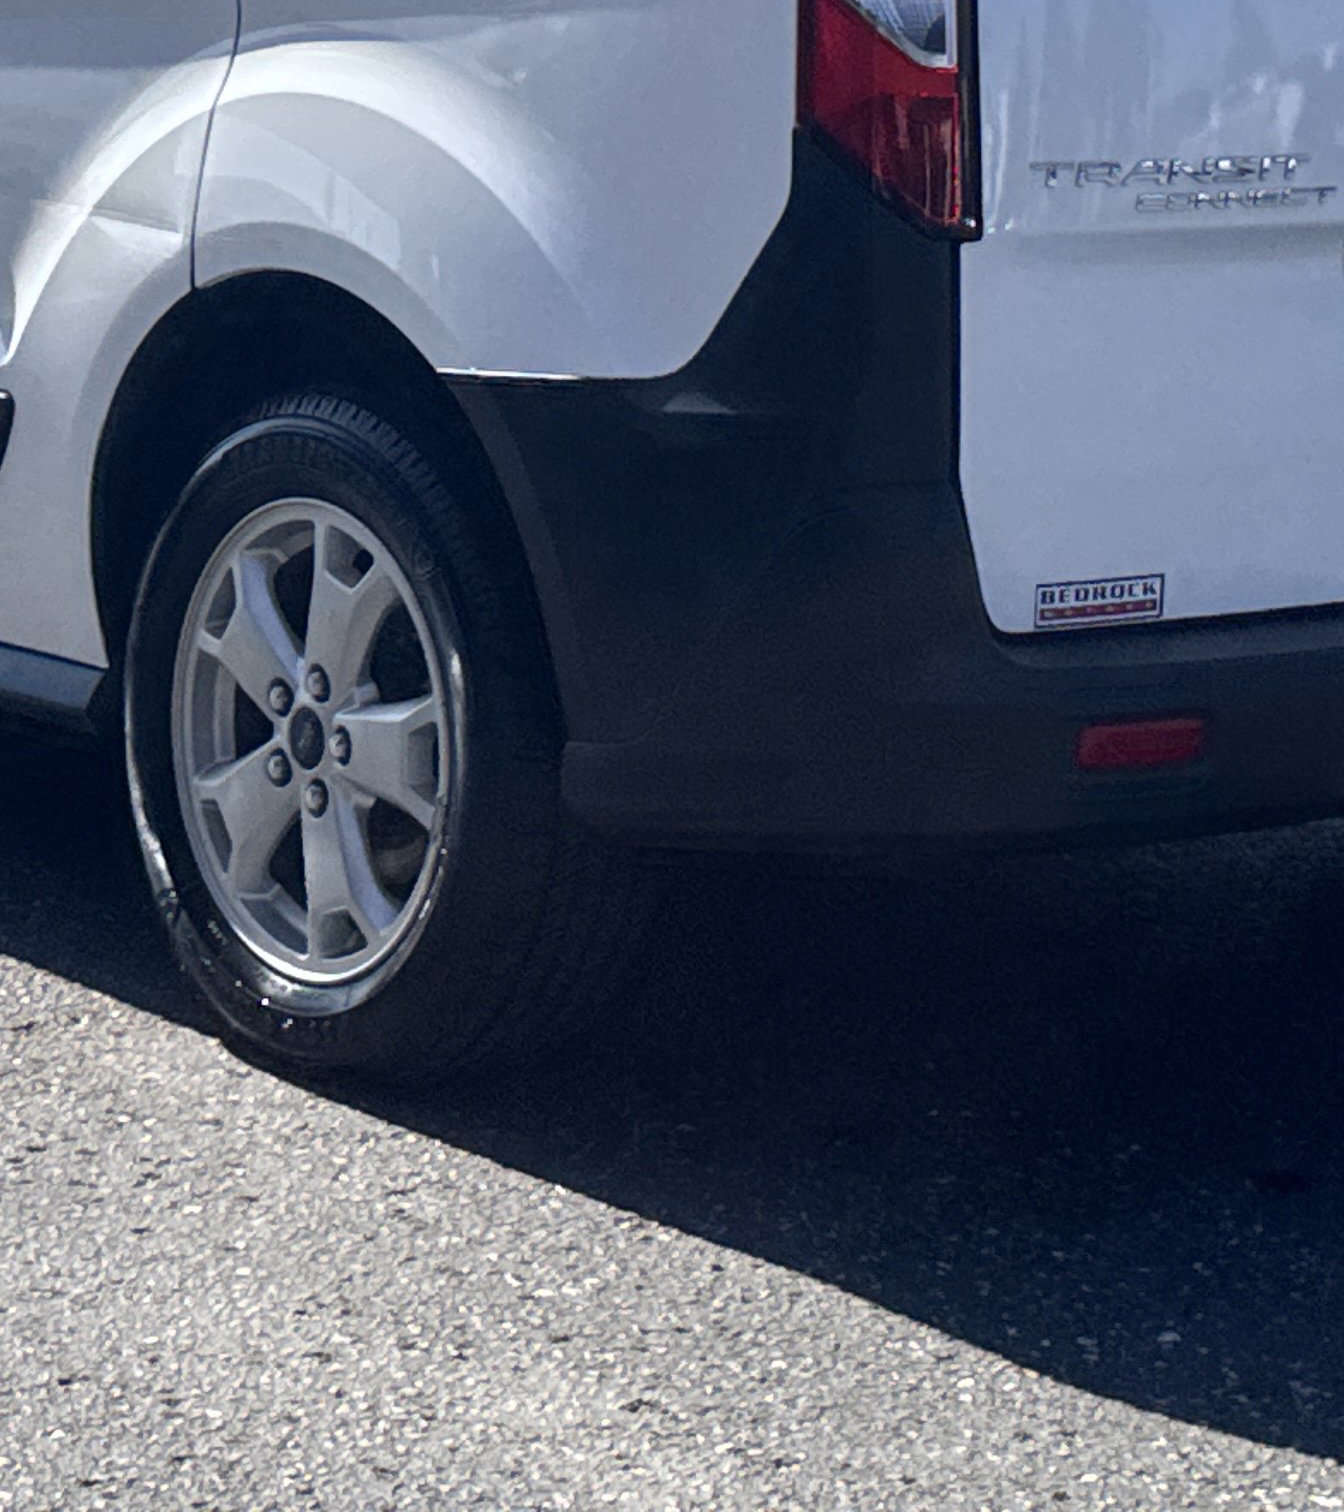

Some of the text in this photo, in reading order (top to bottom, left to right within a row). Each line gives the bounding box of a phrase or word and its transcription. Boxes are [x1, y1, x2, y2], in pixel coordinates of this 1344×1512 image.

[1030, 153, 1312, 187] TRANSIT
[1134, 186, 1338, 212] CONNECT
[1040, 581, 1157, 605] BEDROCK
